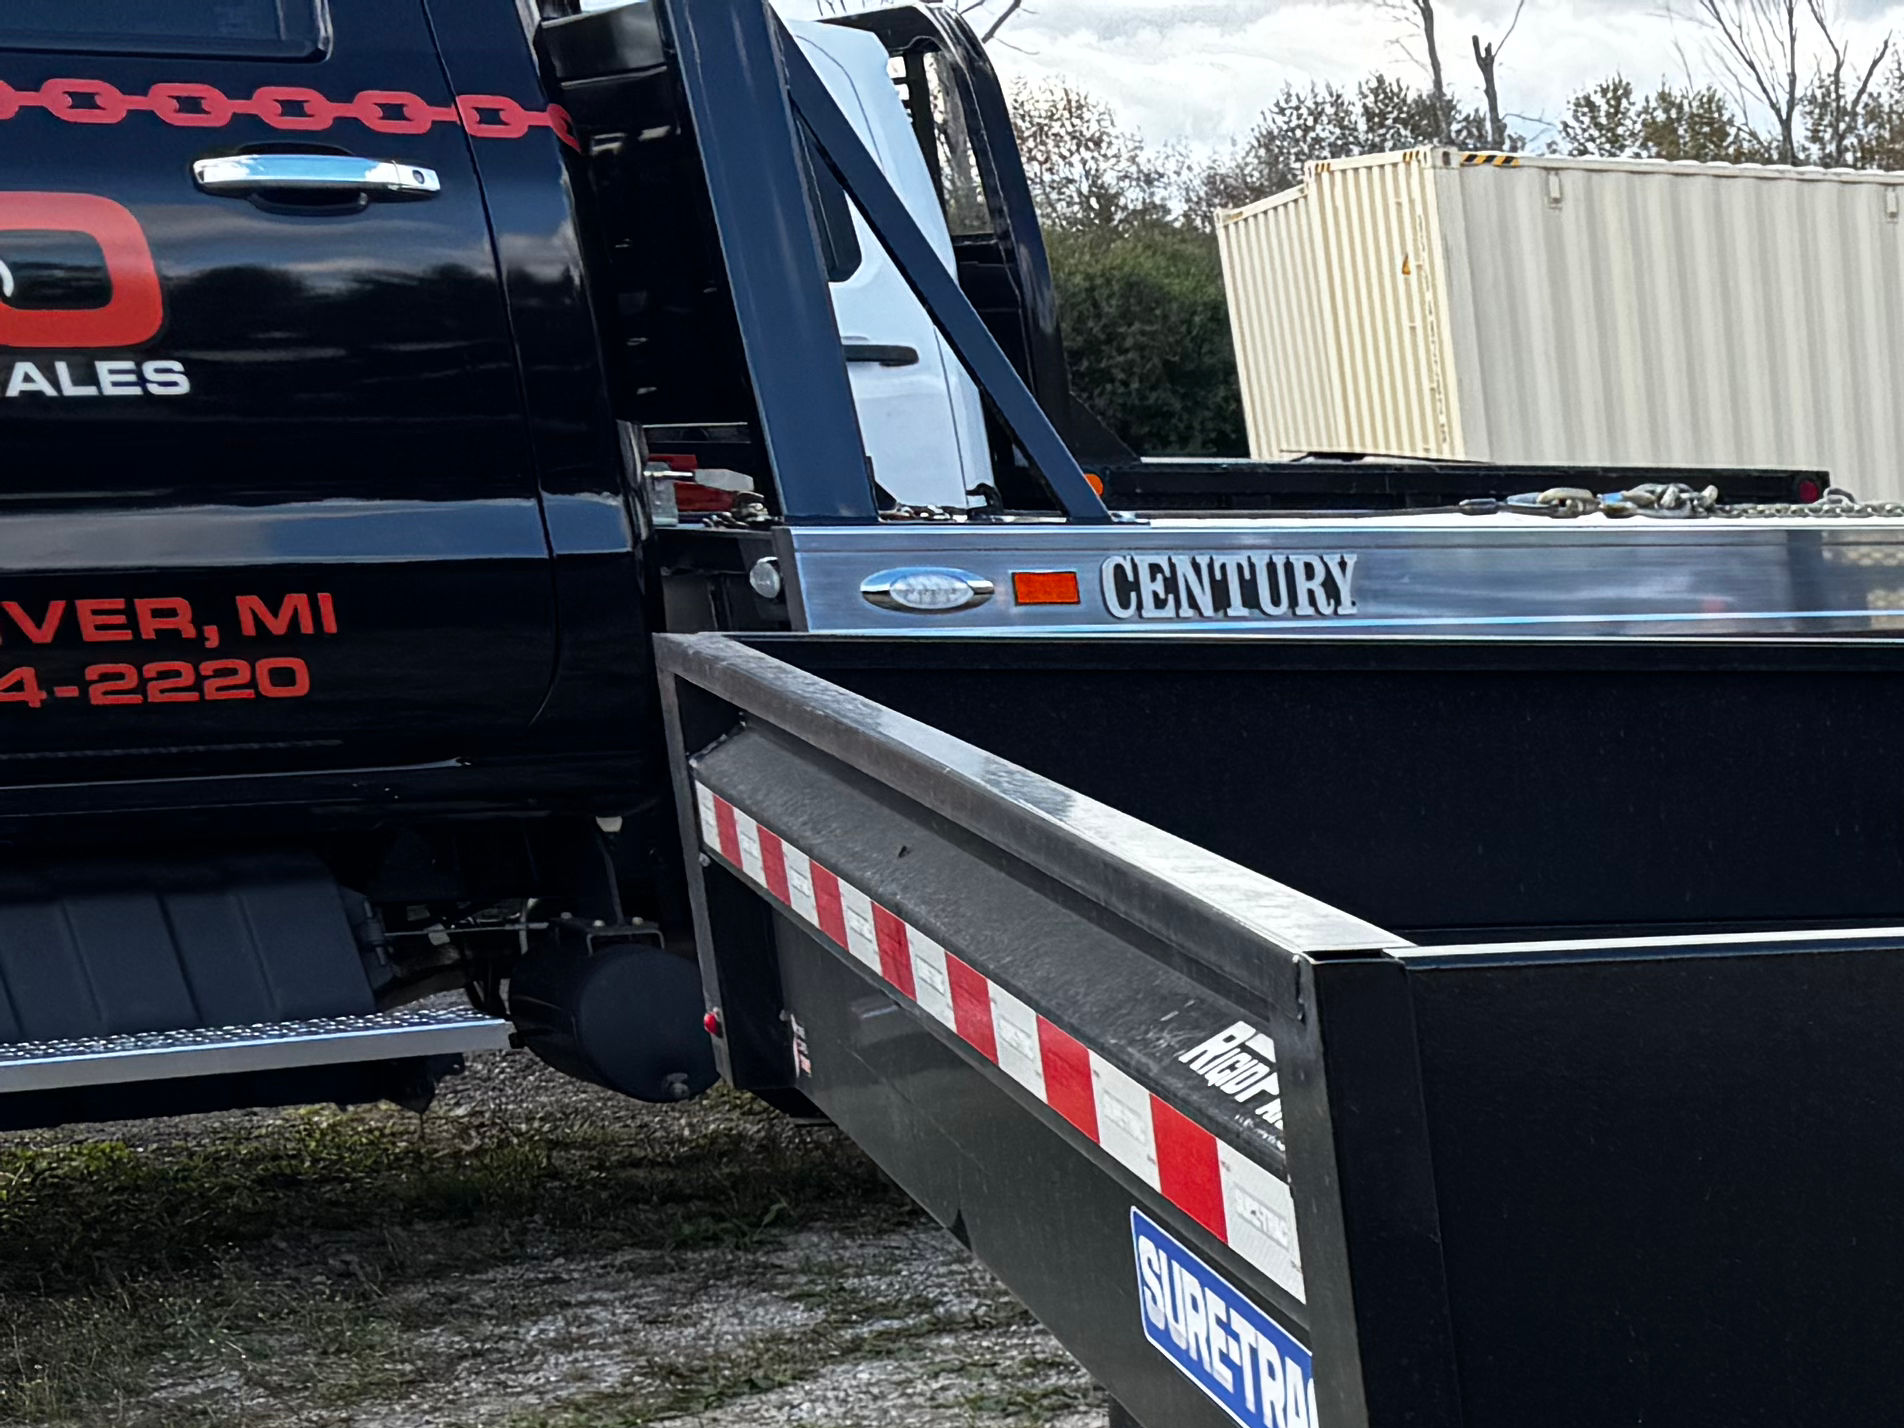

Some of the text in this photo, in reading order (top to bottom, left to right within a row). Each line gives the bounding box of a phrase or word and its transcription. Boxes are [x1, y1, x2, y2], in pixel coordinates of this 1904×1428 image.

[4, 359, 191, 398] ALES
[1100, 553, 1358, 620] CENTURY
[0, 592, 339, 649] VER, MI
[0, 656, 311, 708] 4-2220
